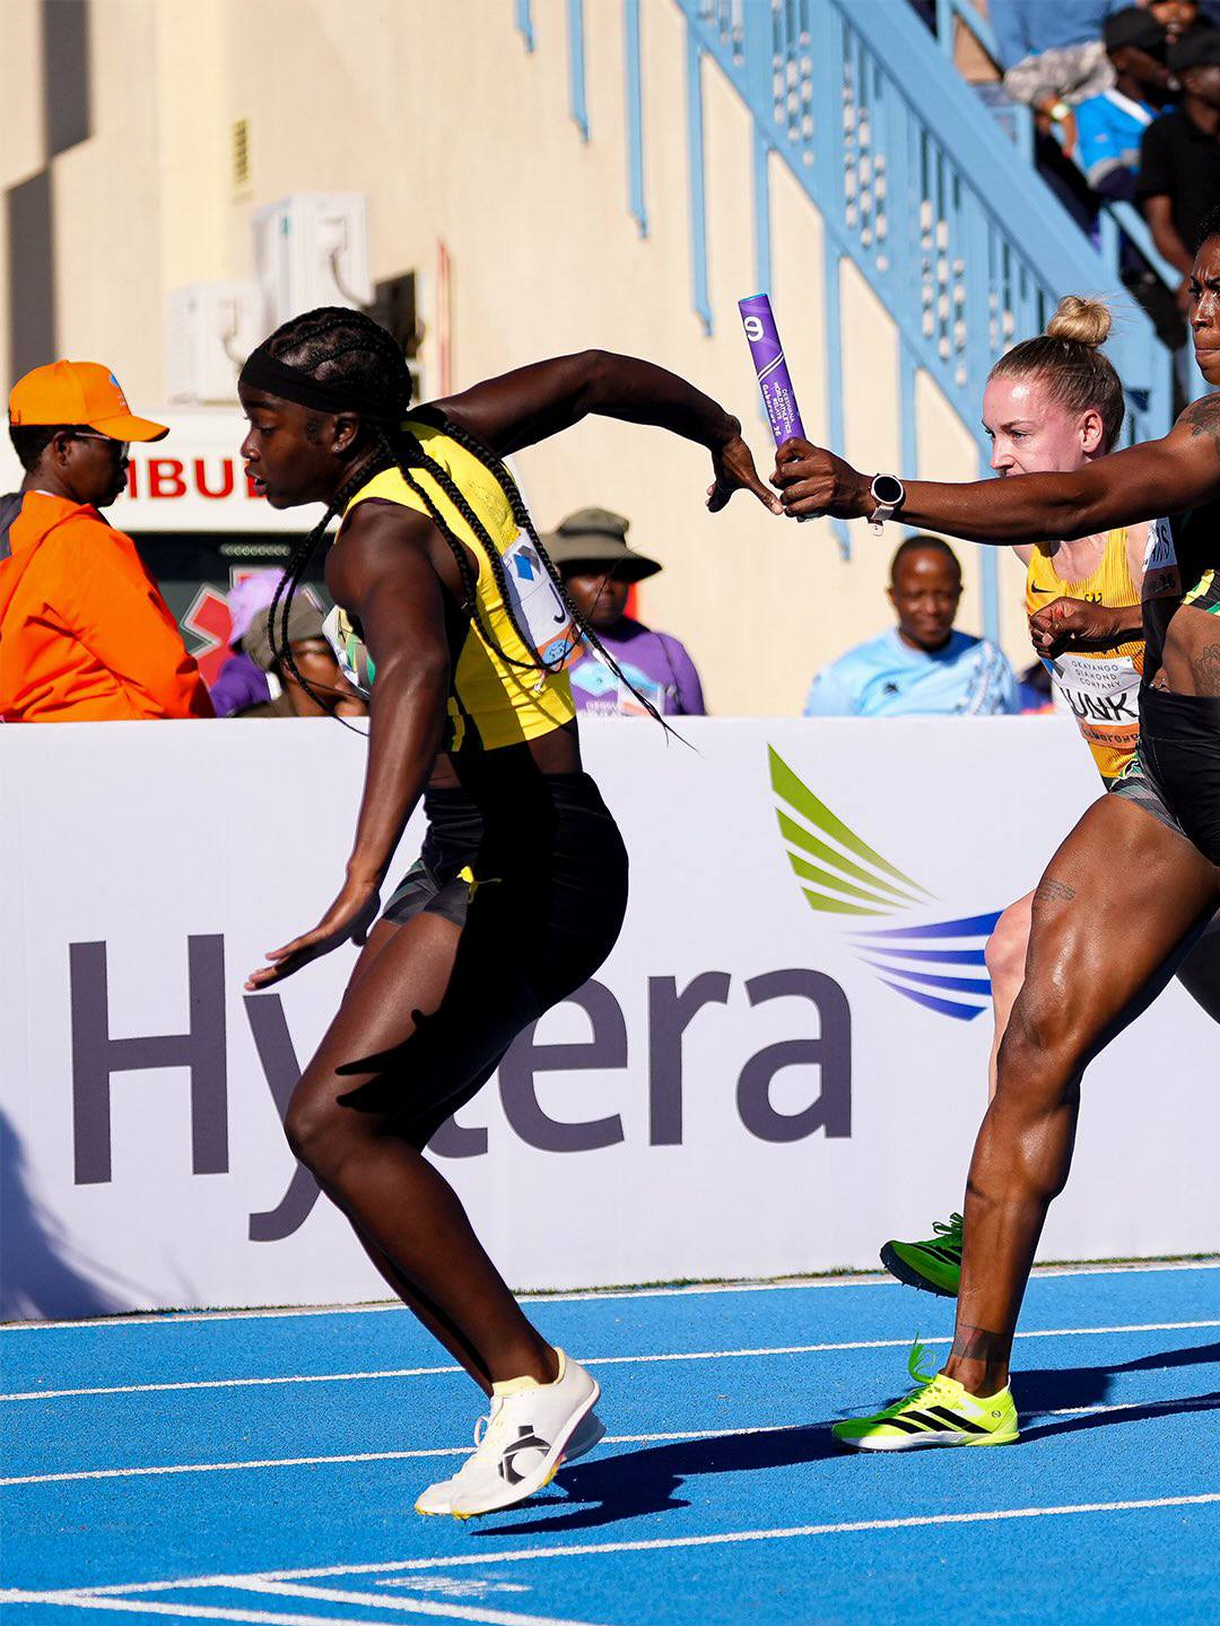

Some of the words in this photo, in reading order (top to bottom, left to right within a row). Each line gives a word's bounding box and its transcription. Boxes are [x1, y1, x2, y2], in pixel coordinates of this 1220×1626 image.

[744, 316, 764, 342] 9
[773, 381, 784, 403] WORLD
[779, 403, 792, 435] ATHLETICS
[1071, 660, 1119, 672] OKAVANGO
[1075, 669, 1117, 681] DIAMOND
[1080, 678, 1121, 690] COMPANY
[69, 934, 852, 1242] Hyera
